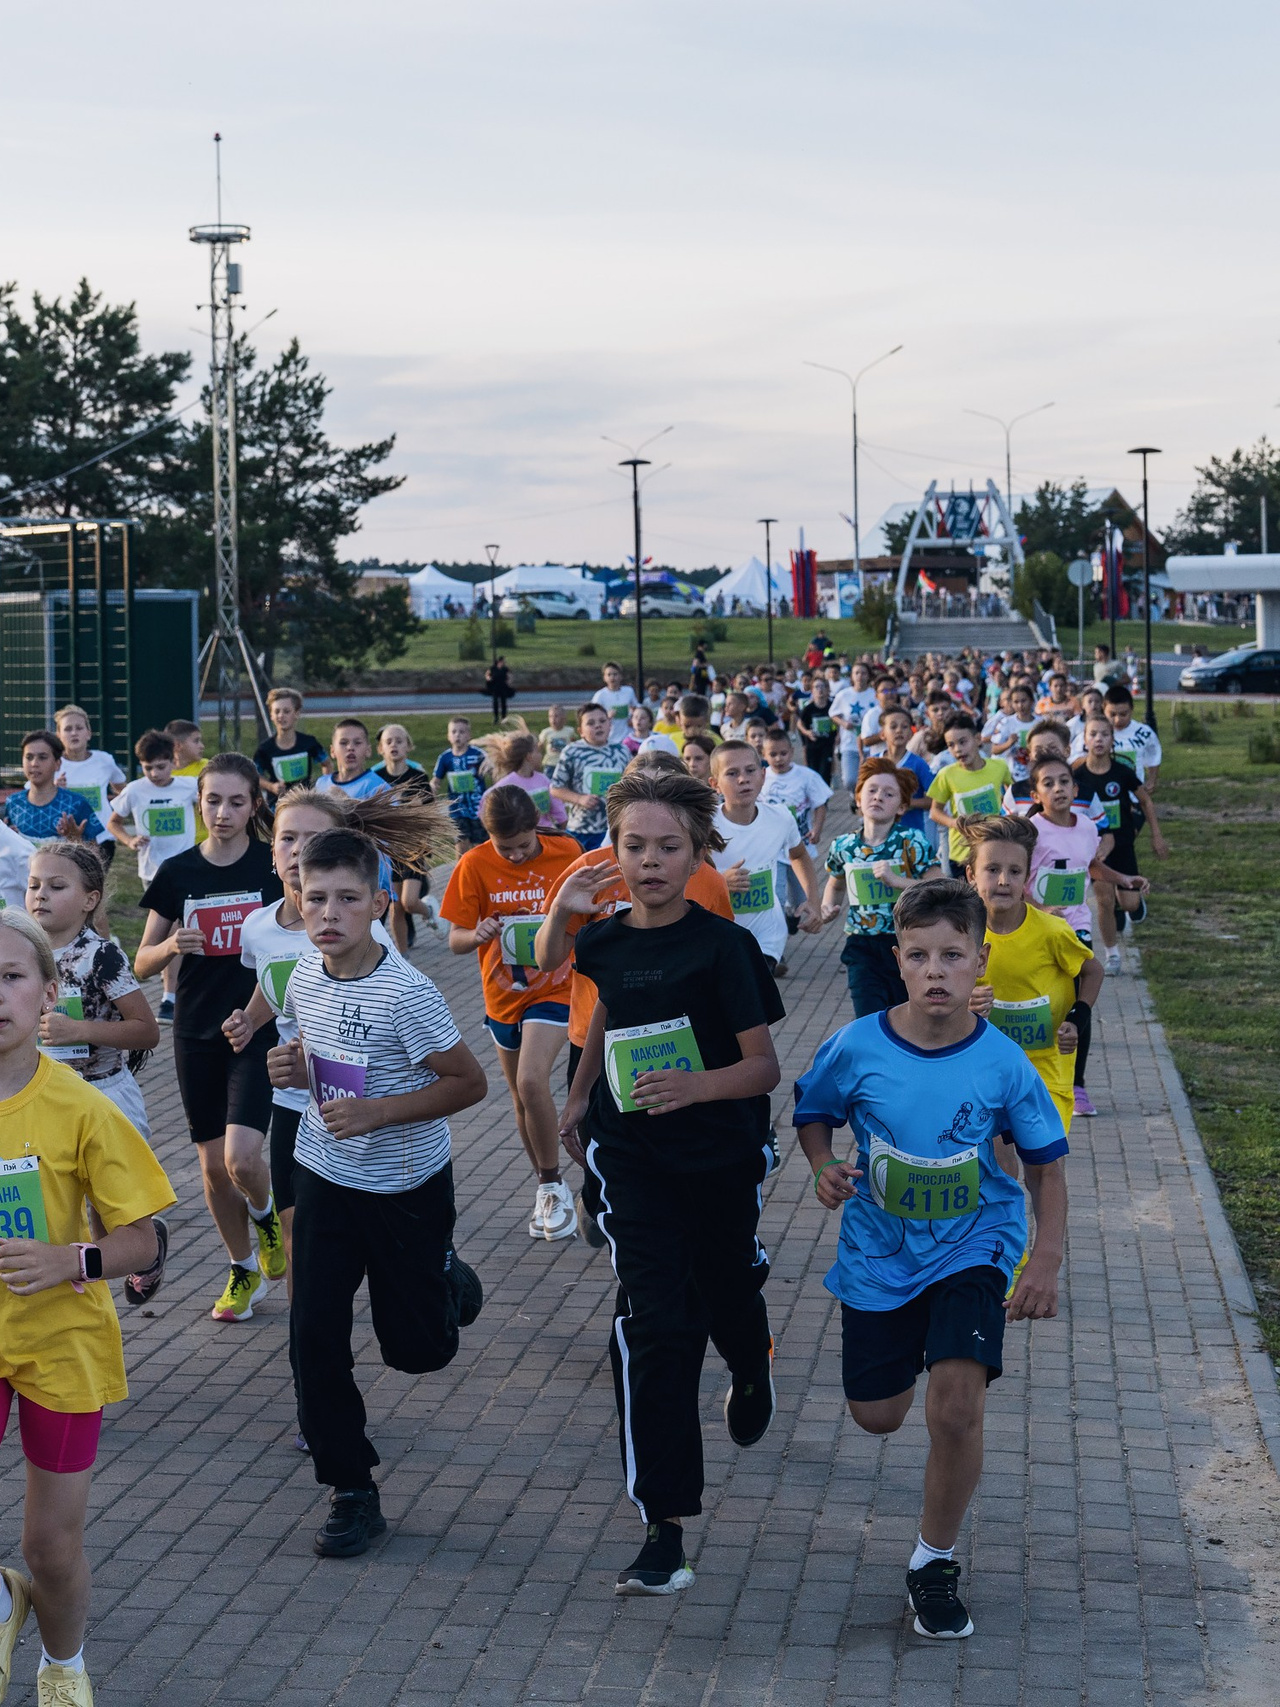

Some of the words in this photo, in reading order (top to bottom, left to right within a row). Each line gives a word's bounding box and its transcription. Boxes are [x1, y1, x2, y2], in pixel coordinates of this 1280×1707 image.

[155, 819, 182, 832] 2433
[732, 887, 770, 909] 3425
[1061, 887, 1076, 901] 76
[221, 911, 243, 923] АННА
[1005, 1013, 1037, 1024] ЛЕОНИД
[338, 1020, 372, 1039] CITY
[631, 1041, 677, 1063] МАКСИМ
[3, 1163, 17, 1171] Пэй
[908, 1172, 961, 1186] ЯРОСЛАВ
[899, 1185, 969, 1212] 4118
